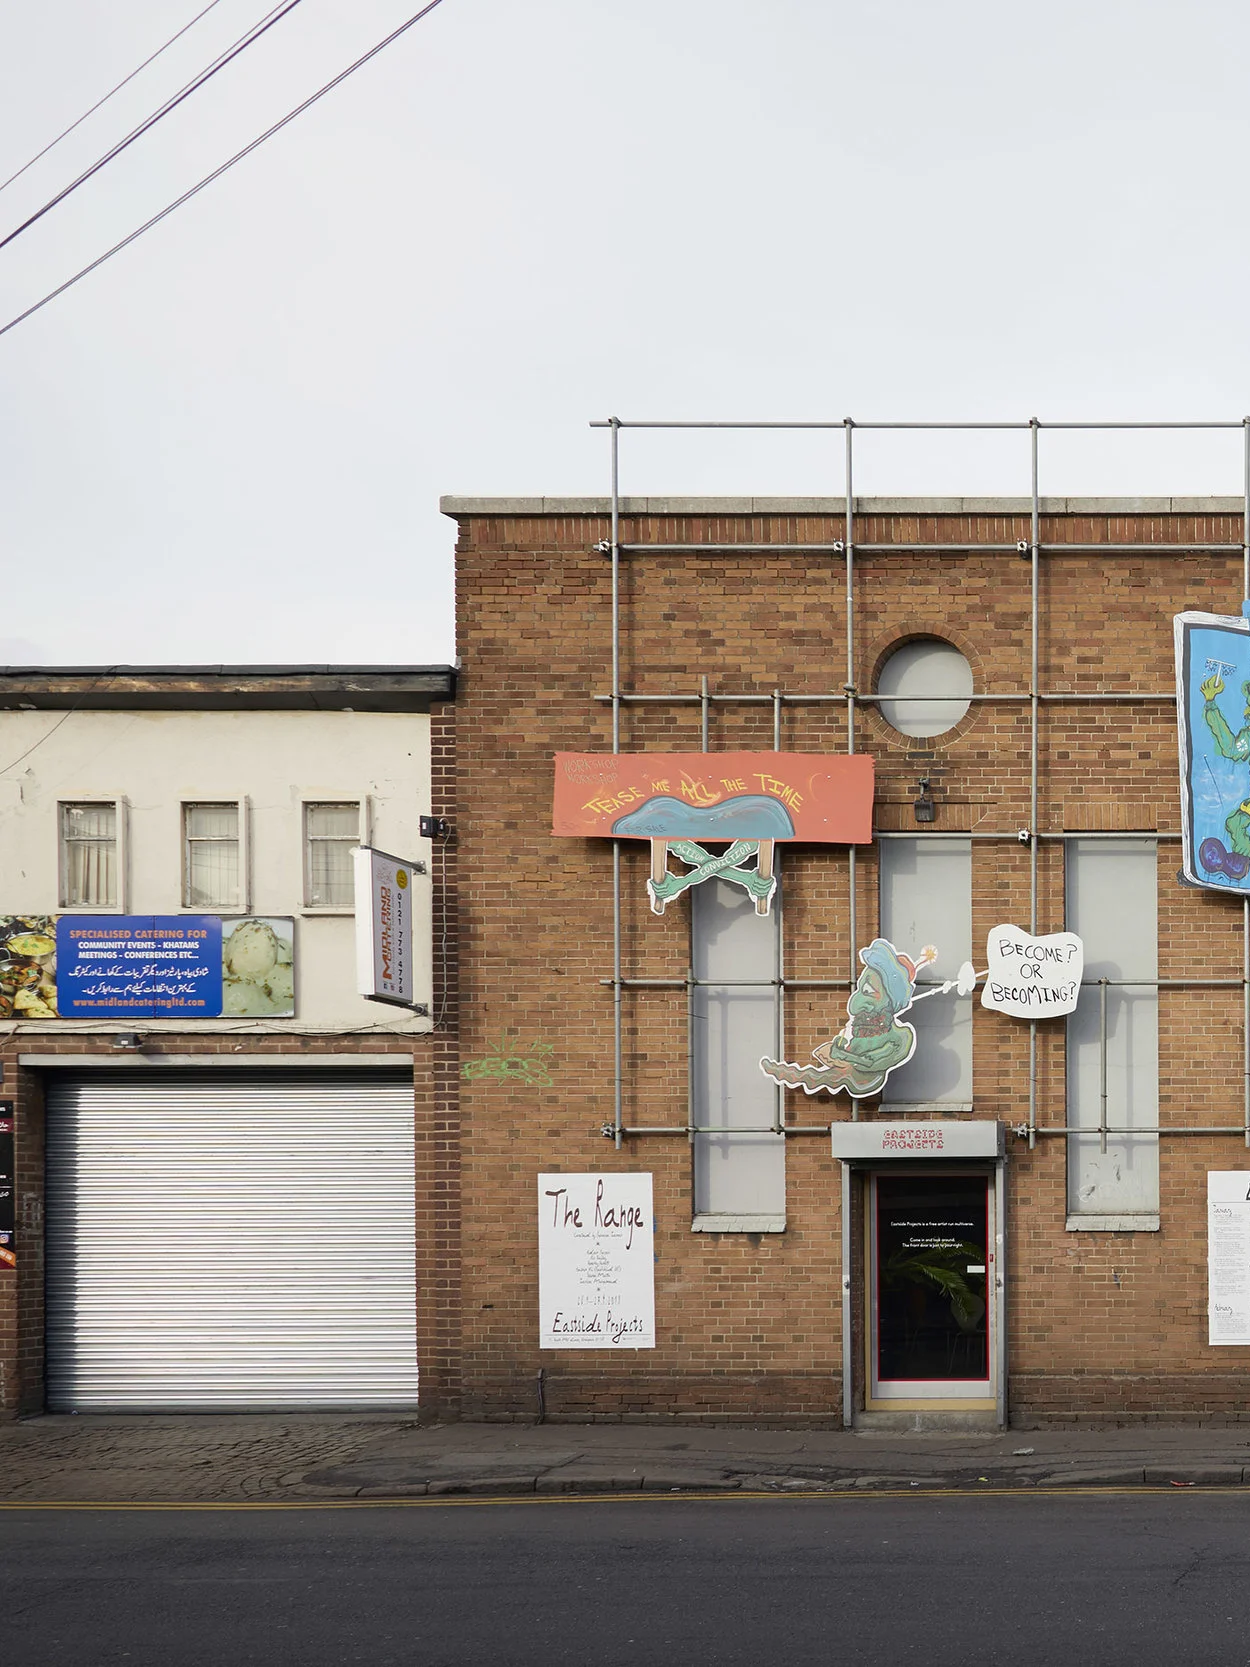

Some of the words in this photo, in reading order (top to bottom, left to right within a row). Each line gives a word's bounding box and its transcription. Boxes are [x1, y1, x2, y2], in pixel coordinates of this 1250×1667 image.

[581, 786, 645, 814] TEASE
[651, 781, 670, 792] ME
[681, 780, 721, 802] ALL
[720, 778, 748, 792] THE
[753, 773, 804, 813] TIME
[677, 843, 705, 863] ACTION
[700, 842, 752, 876] CONVICTION
[69, 930, 132, 939] SPECIALISED
[134, 930, 184, 939] CATERING
[187, 930, 207, 939] FOR
[381, 886, 392, 980] MIDLAND
[78, 941, 127, 949] COMMUNITY
[127, 941, 156, 949] EVENTS
[163, 941, 199, 949] KHATAMS
[78, 951, 117, 959] MEETINGS
[124, 951, 178, 959] CONFERENCES
[998, 939, 1078, 964] BECOME?
[1019, 963, 1044, 980] OR
[73, 997, 205, 1009] www.midlandcateringltd.com
[990, 980, 1077, 1006] BECOMING?
[882, 1140, 944, 1149] PROJECTS
[884, 1130, 943, 1139] EASTSIDE
[545, 1189, 582, 1228] The
[595, 1179, 644, 1250] Range
[552, 1312, 601, 1333] Eastside
[606, 1310, 643, 1344] Projects
